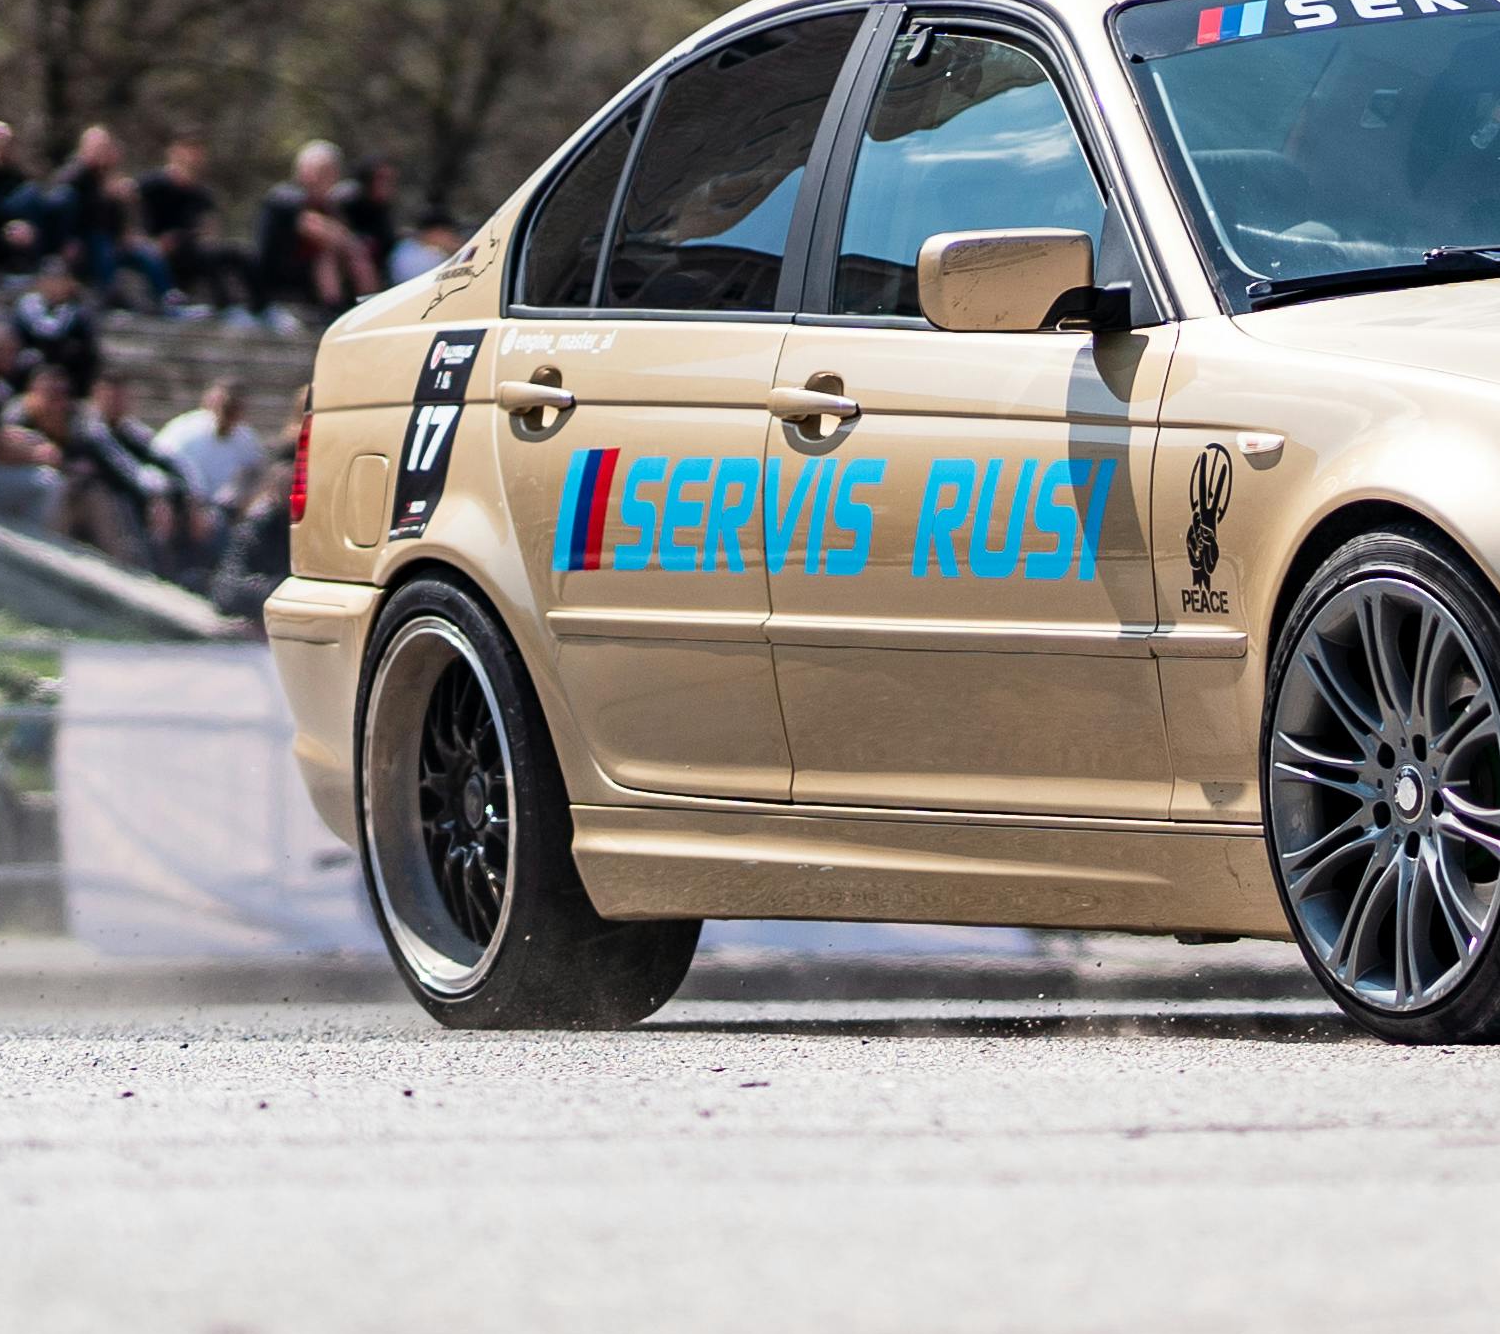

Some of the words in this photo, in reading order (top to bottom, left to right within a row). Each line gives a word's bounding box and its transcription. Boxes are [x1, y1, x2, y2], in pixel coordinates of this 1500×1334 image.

[407, 405, 460, 471] 17
[613, 456, 888, 575] SERVIS
[911, 458, 1119, 581] RUSI
[1181, 589, 1230, 614] PEACE
